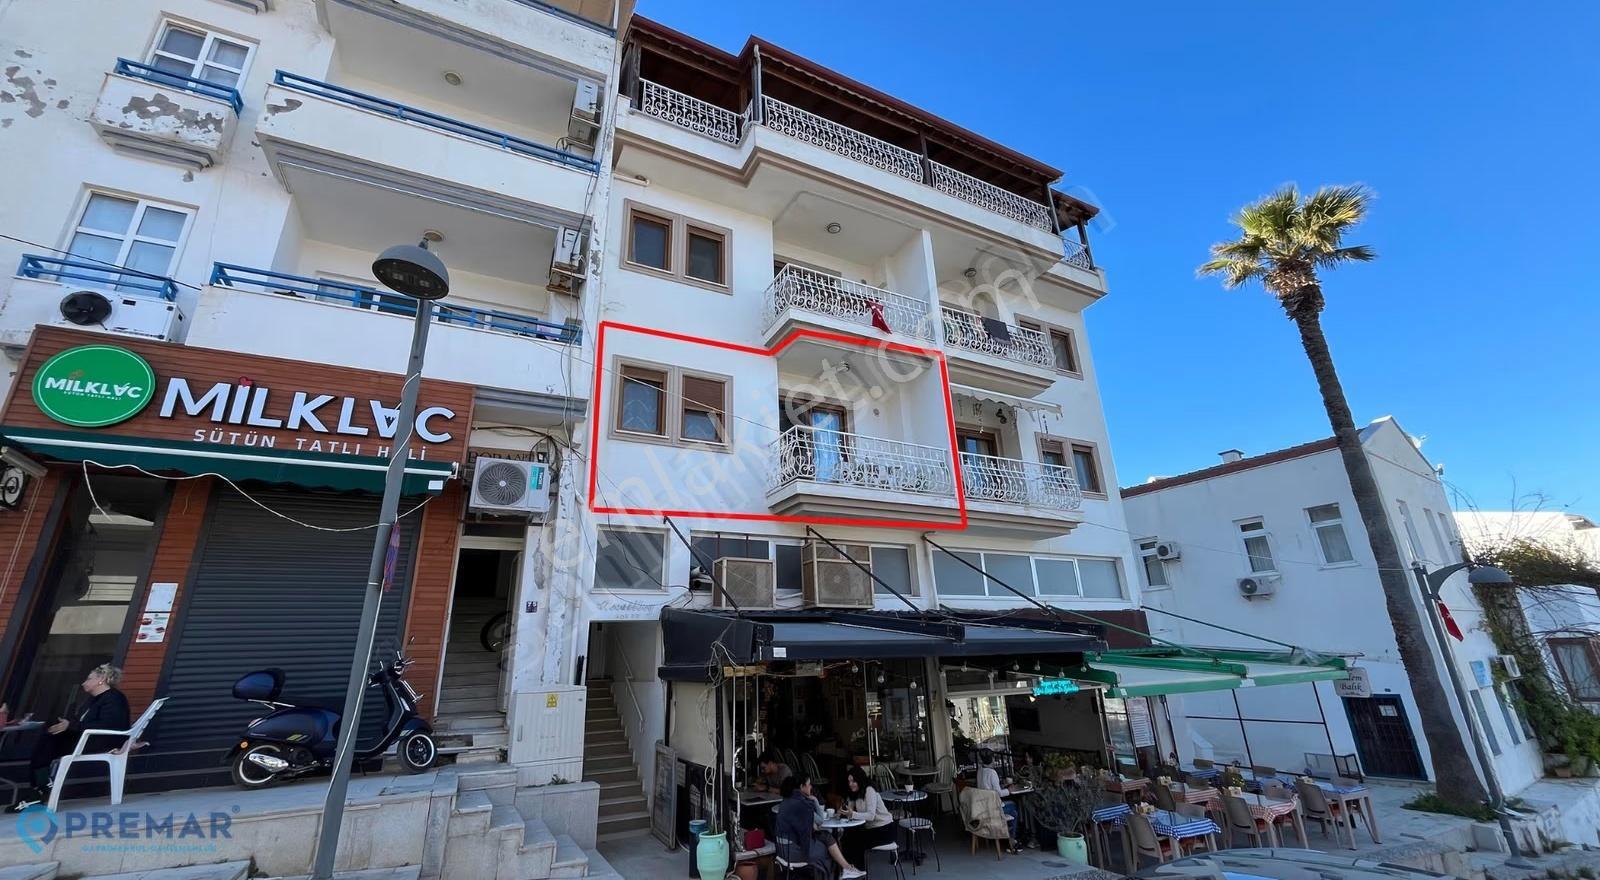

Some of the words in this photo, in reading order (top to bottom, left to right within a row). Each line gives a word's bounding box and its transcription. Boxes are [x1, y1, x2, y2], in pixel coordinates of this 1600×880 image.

[193, 429, 276, 448] SÜTÜN
[295, 438, 361, 455] TATLI
[377, 445, 427, 461] HLİ
